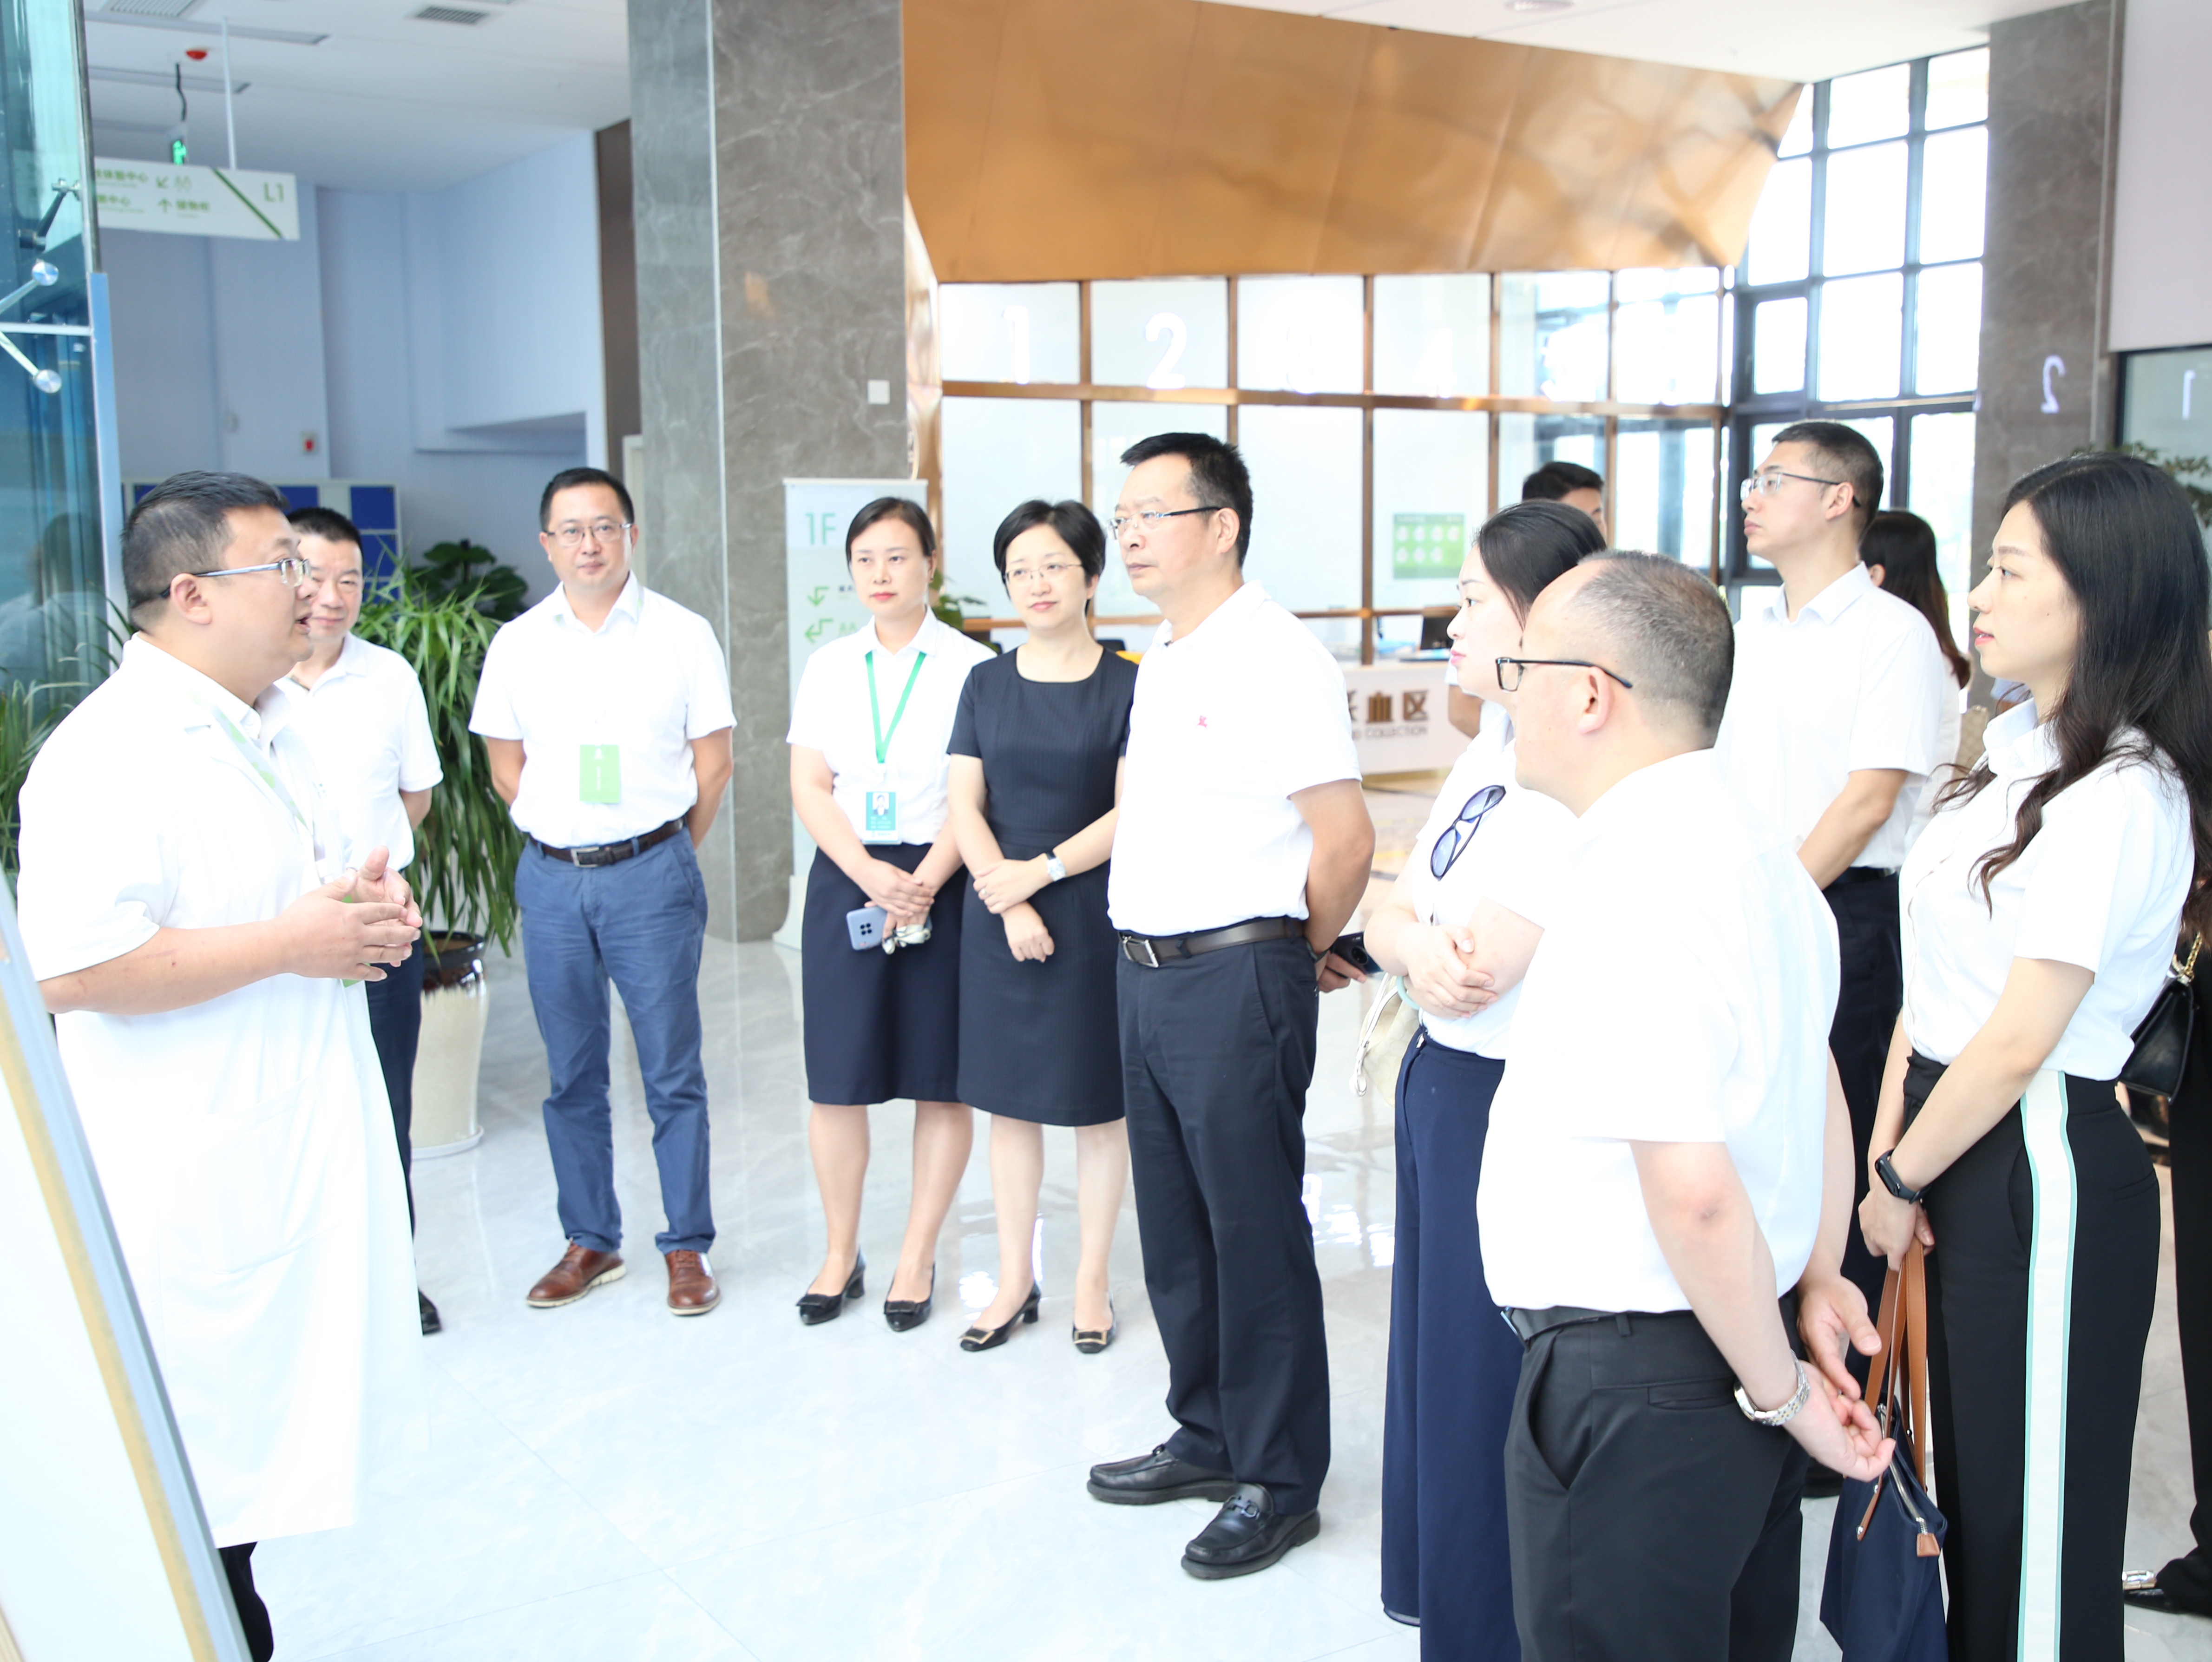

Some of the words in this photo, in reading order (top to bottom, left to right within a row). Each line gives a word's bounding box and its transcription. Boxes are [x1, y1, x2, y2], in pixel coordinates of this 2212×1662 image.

[264, 182, 285, 203] L1
[1003, 305, 1029, 385] 1
[1144, 312, 1188, 389] 2
[805, 512, 837, 545] 1F
